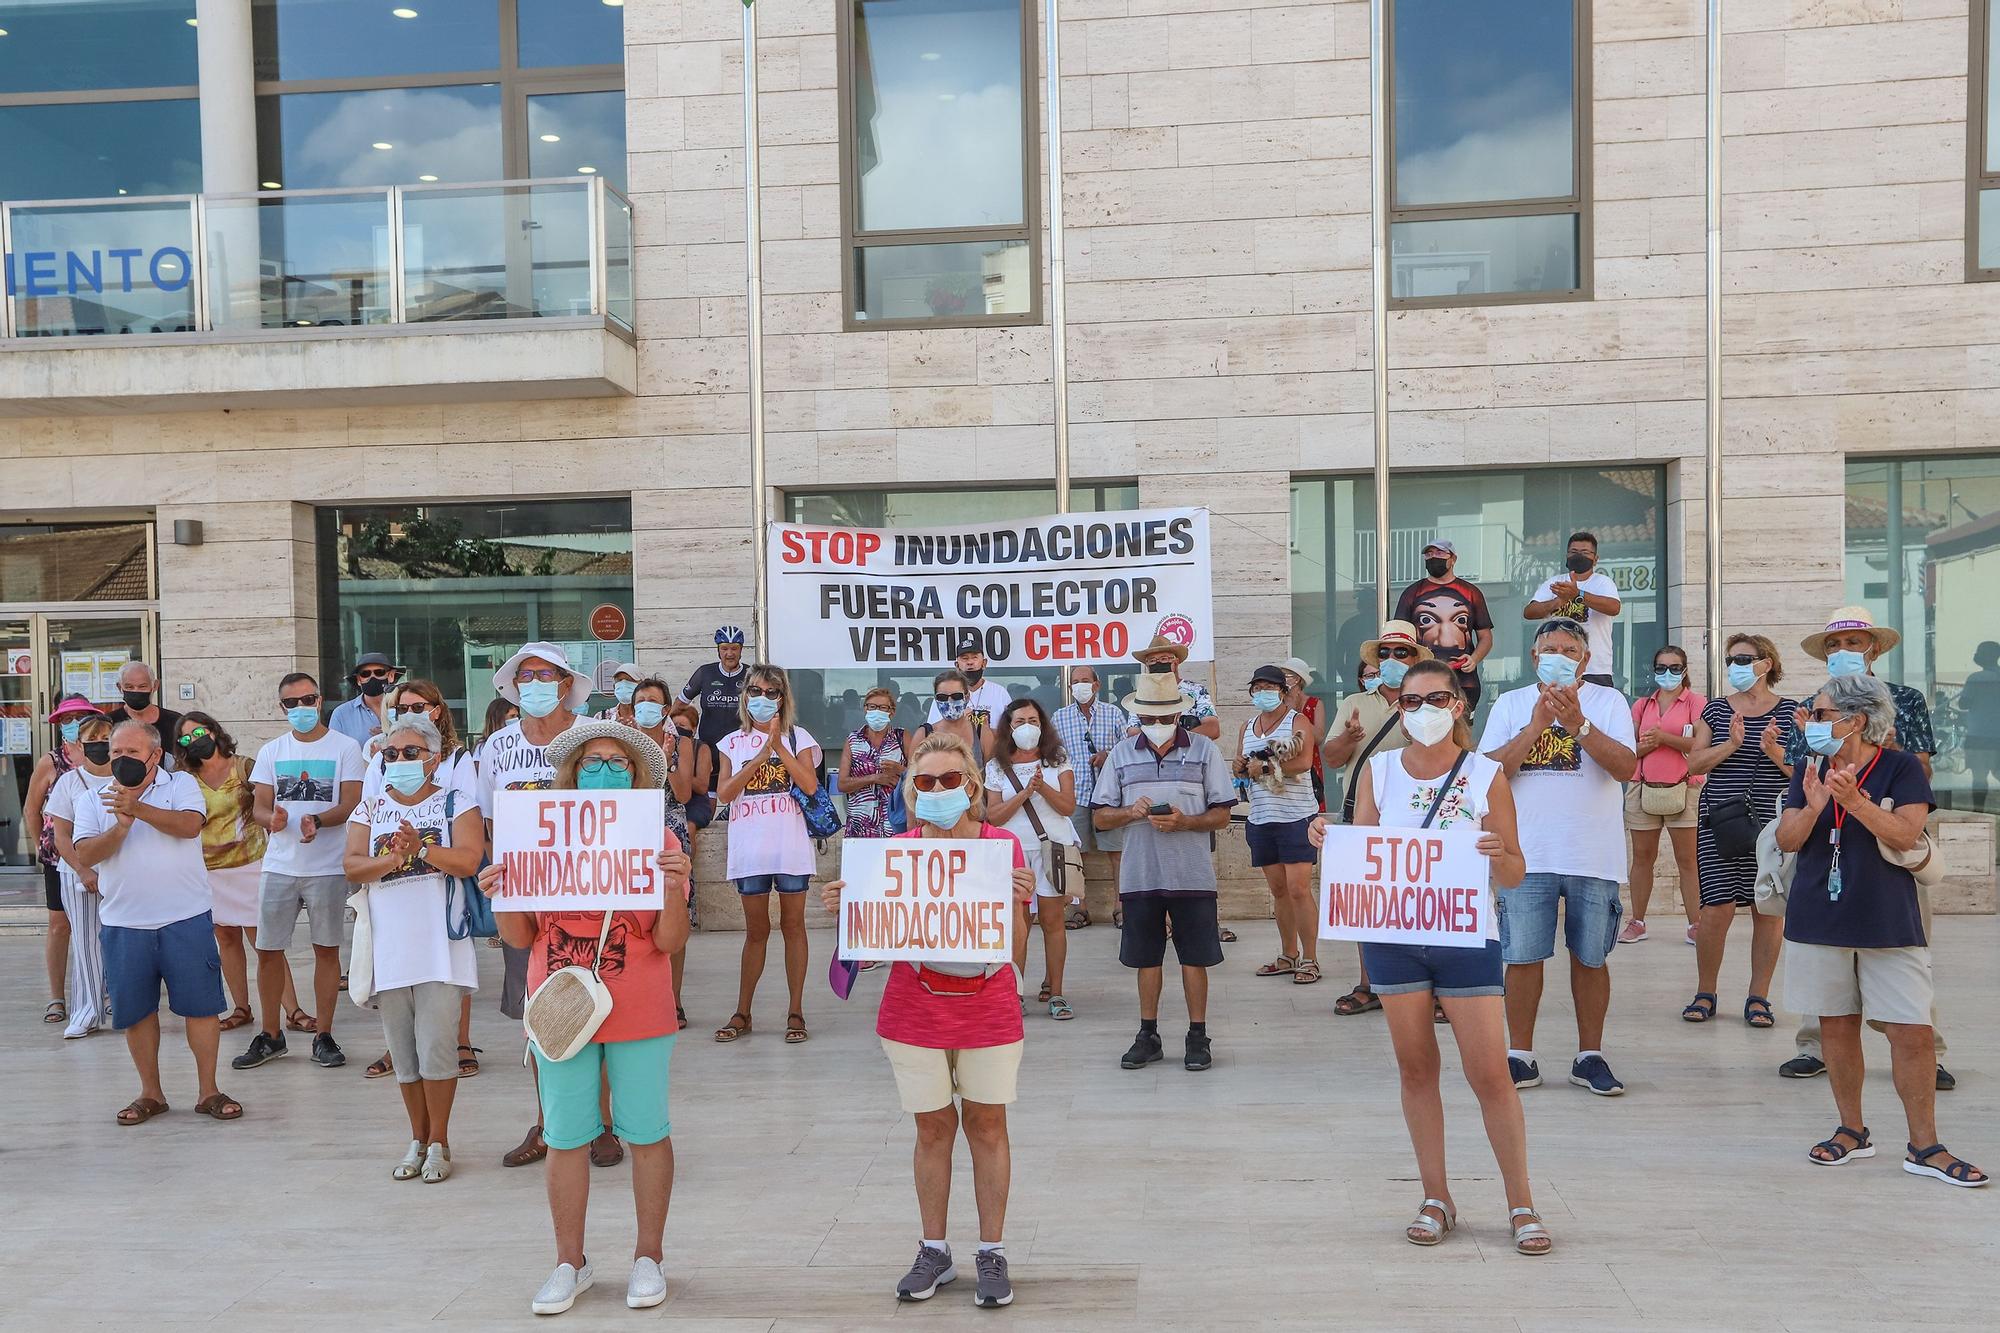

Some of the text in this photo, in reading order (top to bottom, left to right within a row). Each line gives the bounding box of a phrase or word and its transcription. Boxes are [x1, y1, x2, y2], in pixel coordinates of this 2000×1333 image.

[782, 517, 1195, 566] STOP INUNDACIONES
[820, 577, 1158, 620] FUERA COLECTOR
[1025, 620, 1129, 661] CERO
[538, 800, 617, 847] STOP
[502, 849, 655, 898] INUNDACIONES
[884, 849, 966, 898] STOP
[1365, 836, 1443, 883] STOP
[847, 901, 1005, 950] INUNDACIONES
[1329, 883, 1478, 933] INUNDACIONES
